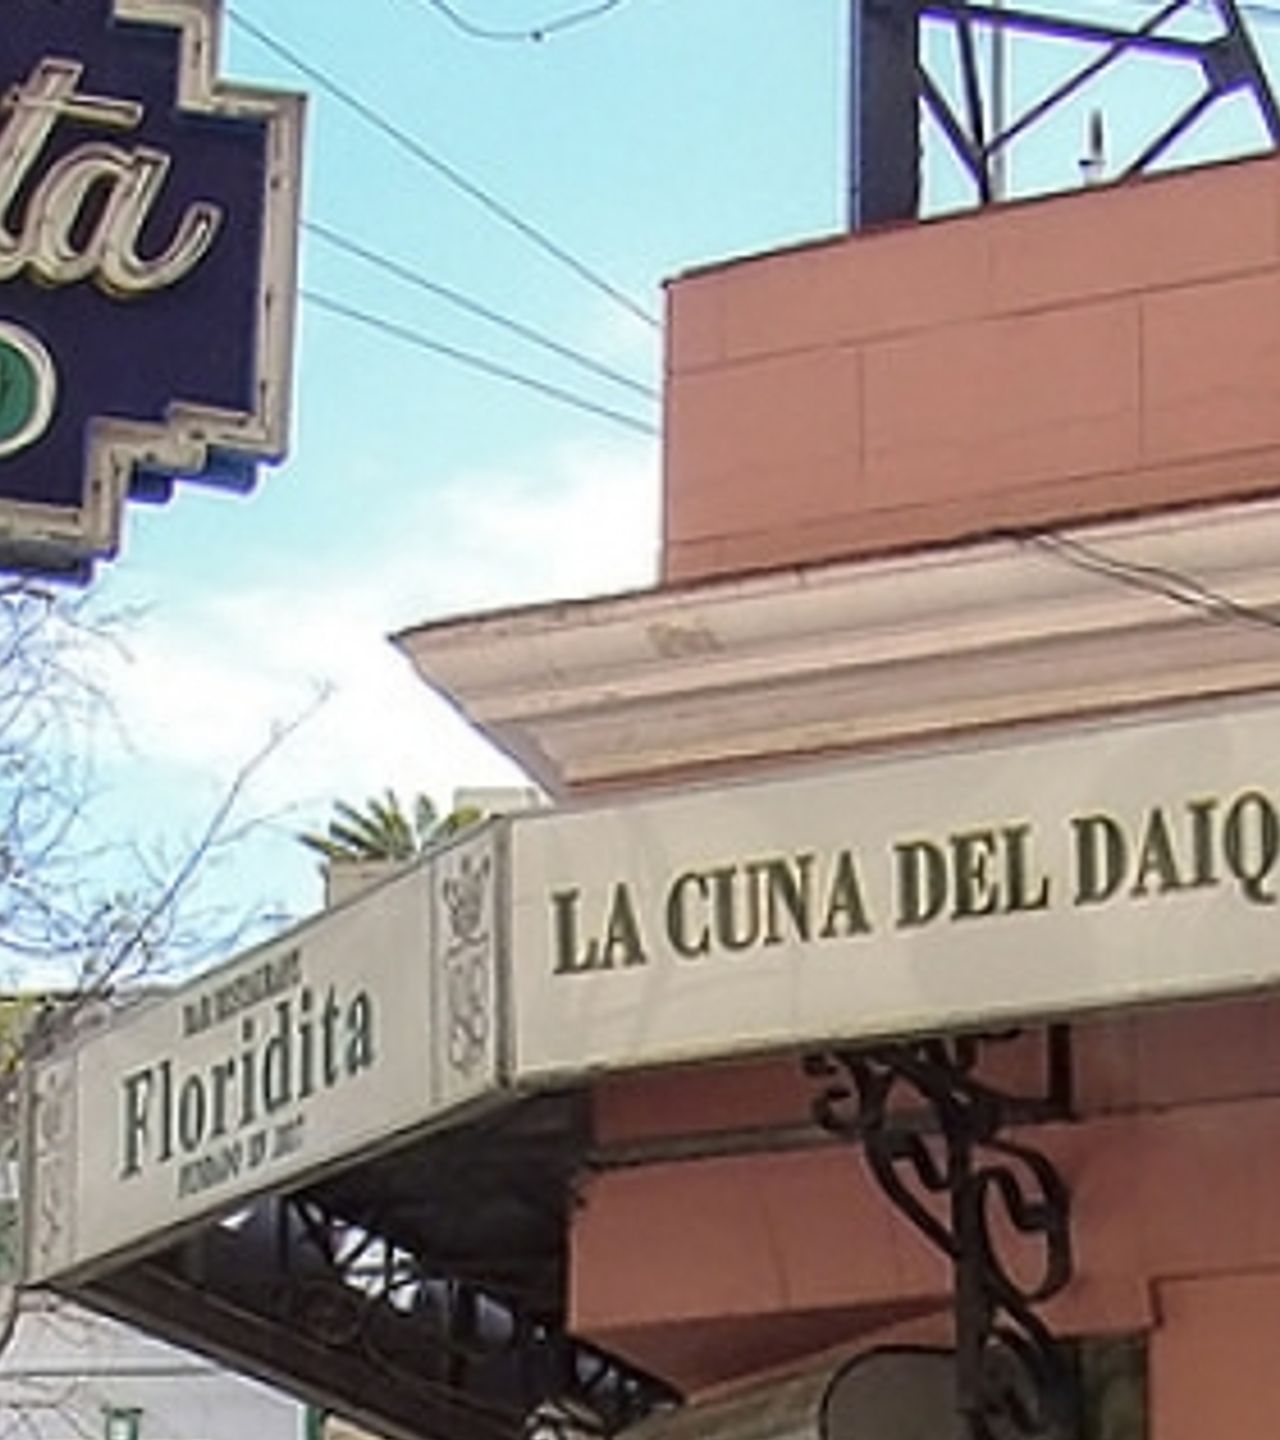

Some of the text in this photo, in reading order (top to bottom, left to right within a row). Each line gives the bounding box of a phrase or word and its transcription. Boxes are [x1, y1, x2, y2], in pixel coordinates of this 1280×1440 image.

[549, 881, 648, 976] LA
[664, 849, 872, 960] CUNA
[892, 823, 1050, 929] DEL
[118, 982, 376, 1180] Floridita
